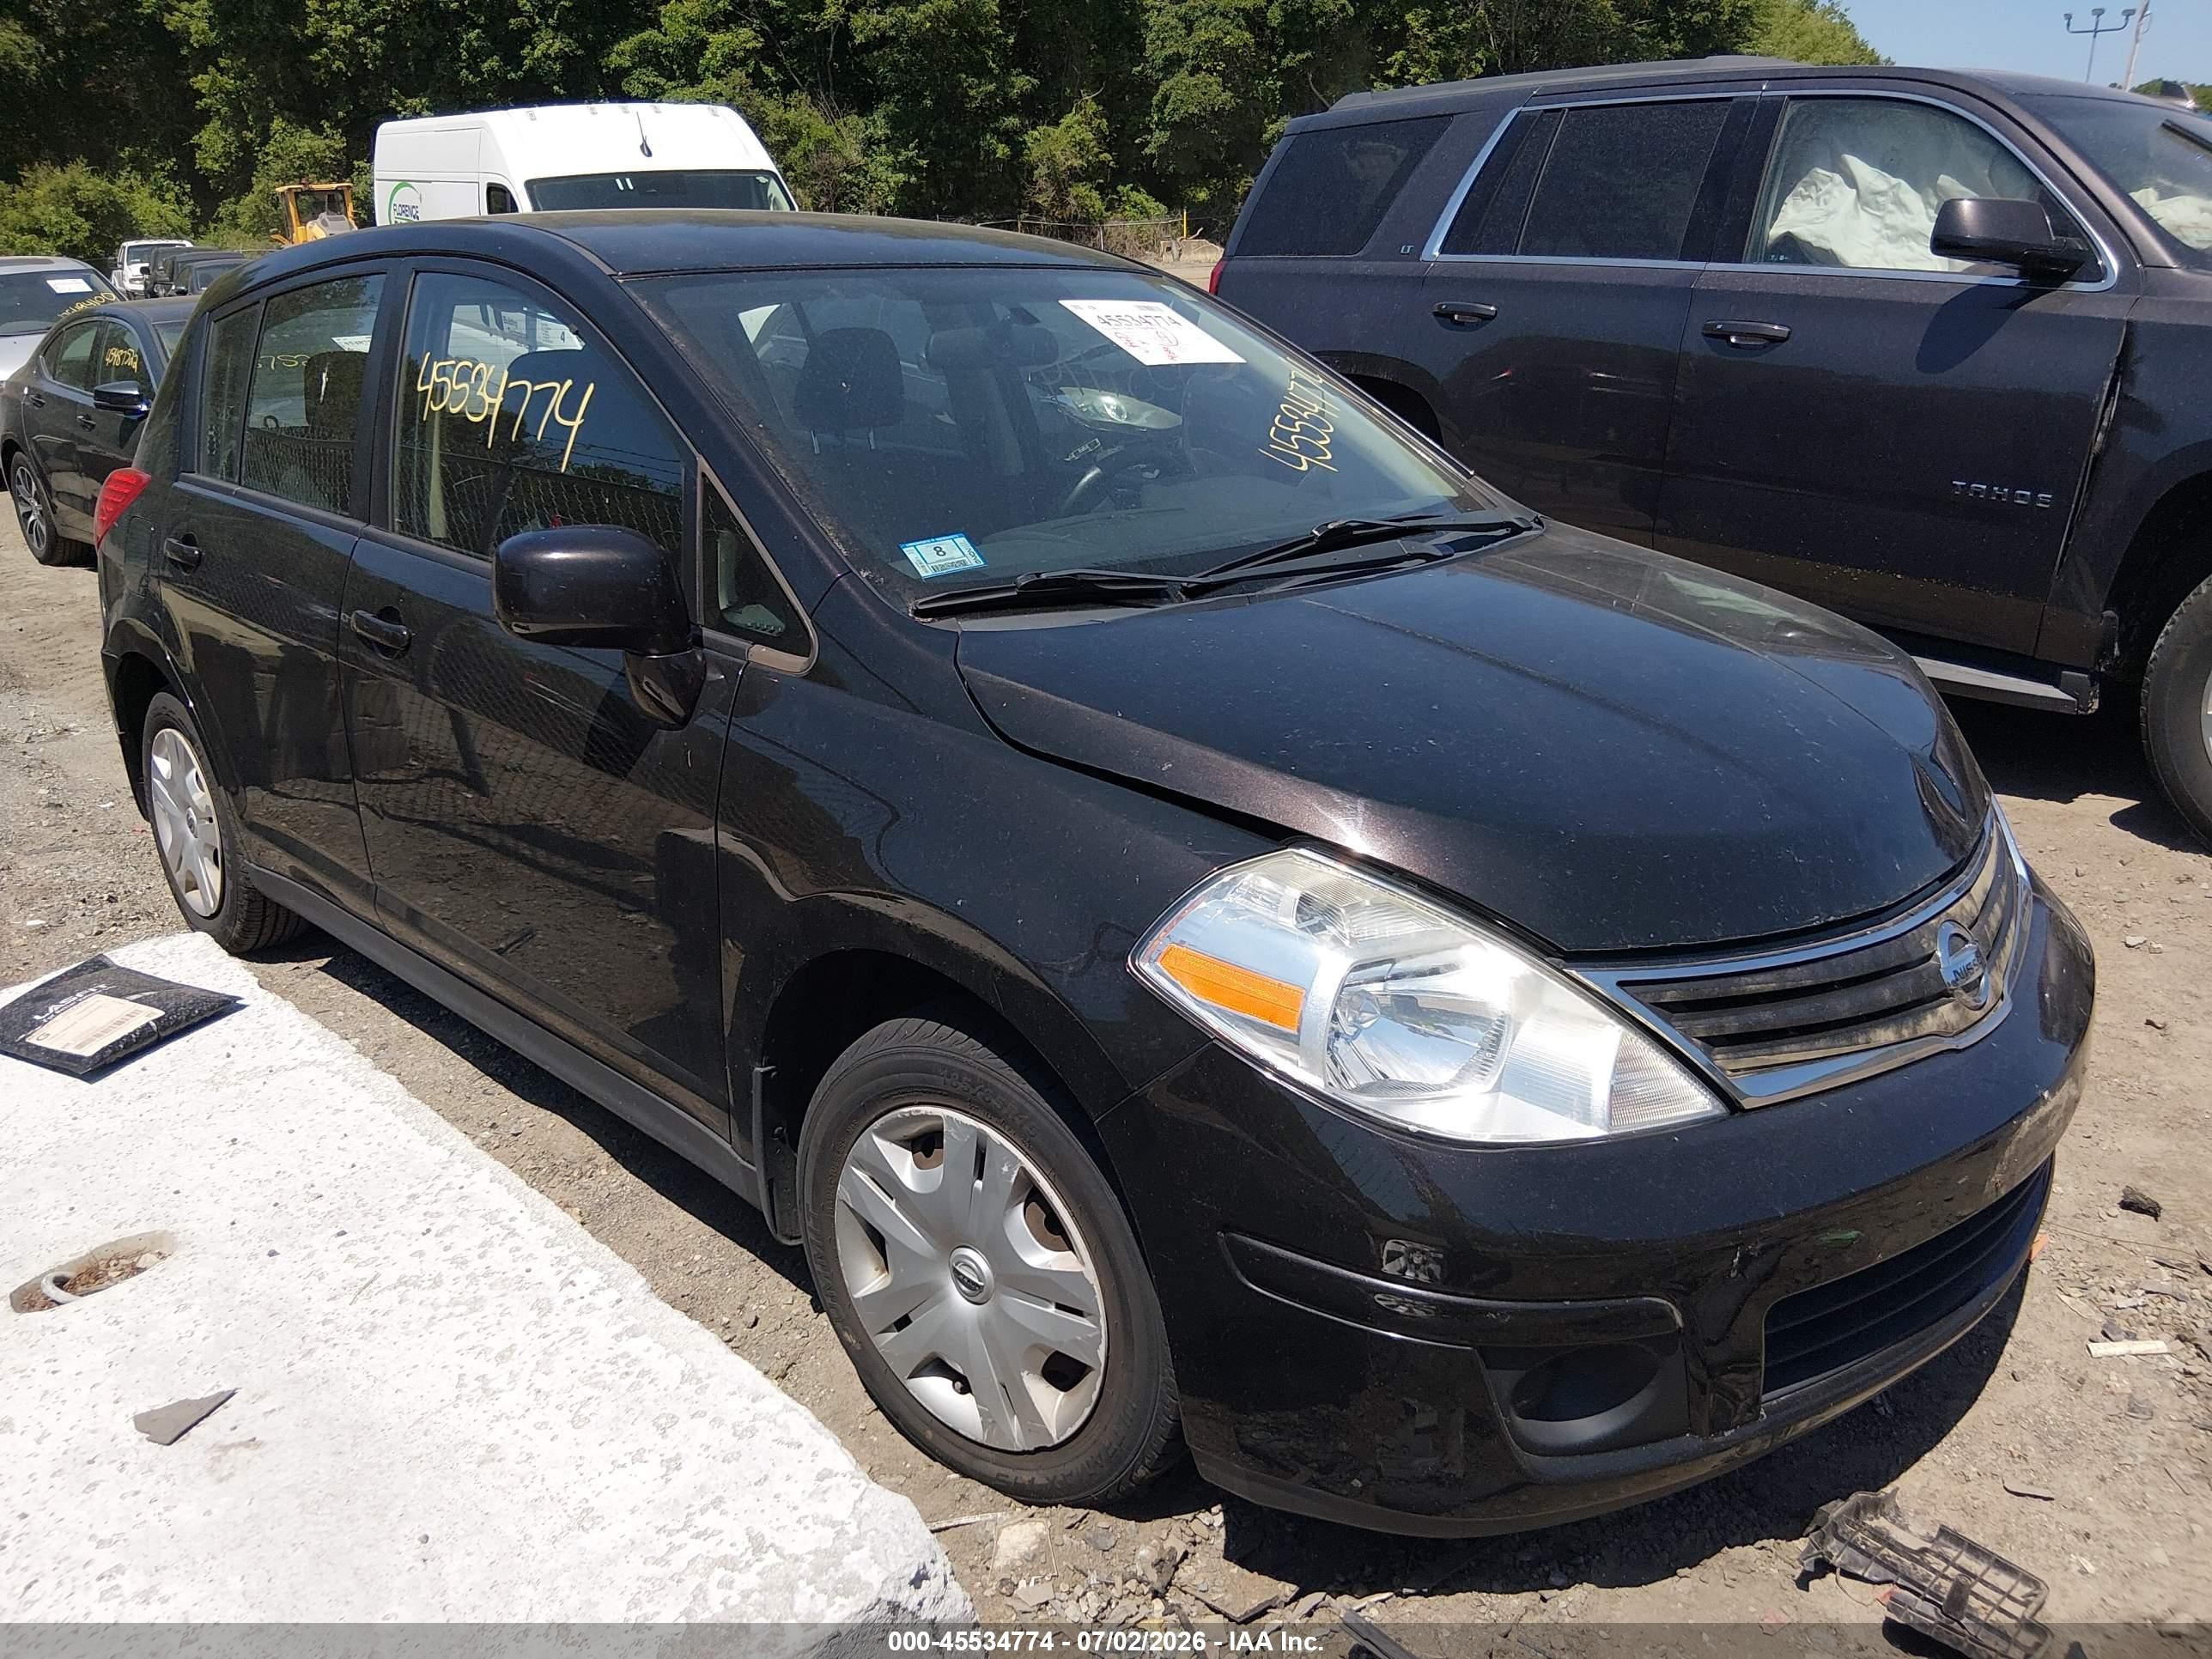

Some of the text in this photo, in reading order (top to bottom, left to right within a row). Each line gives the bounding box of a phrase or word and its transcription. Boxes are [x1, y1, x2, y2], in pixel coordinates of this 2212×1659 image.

[392, 203, 420, 221] FLORENCE
[1401, 245, 1414, 254] LT
[1096, 314, 1182, 327] 45534774
[416, 351, 595, 474] 45534774
[1257, 356, 1341, 471] 45534774
[1952, 480, 2053, 508] TAHOE
[933, 545, 946, 557] 8
